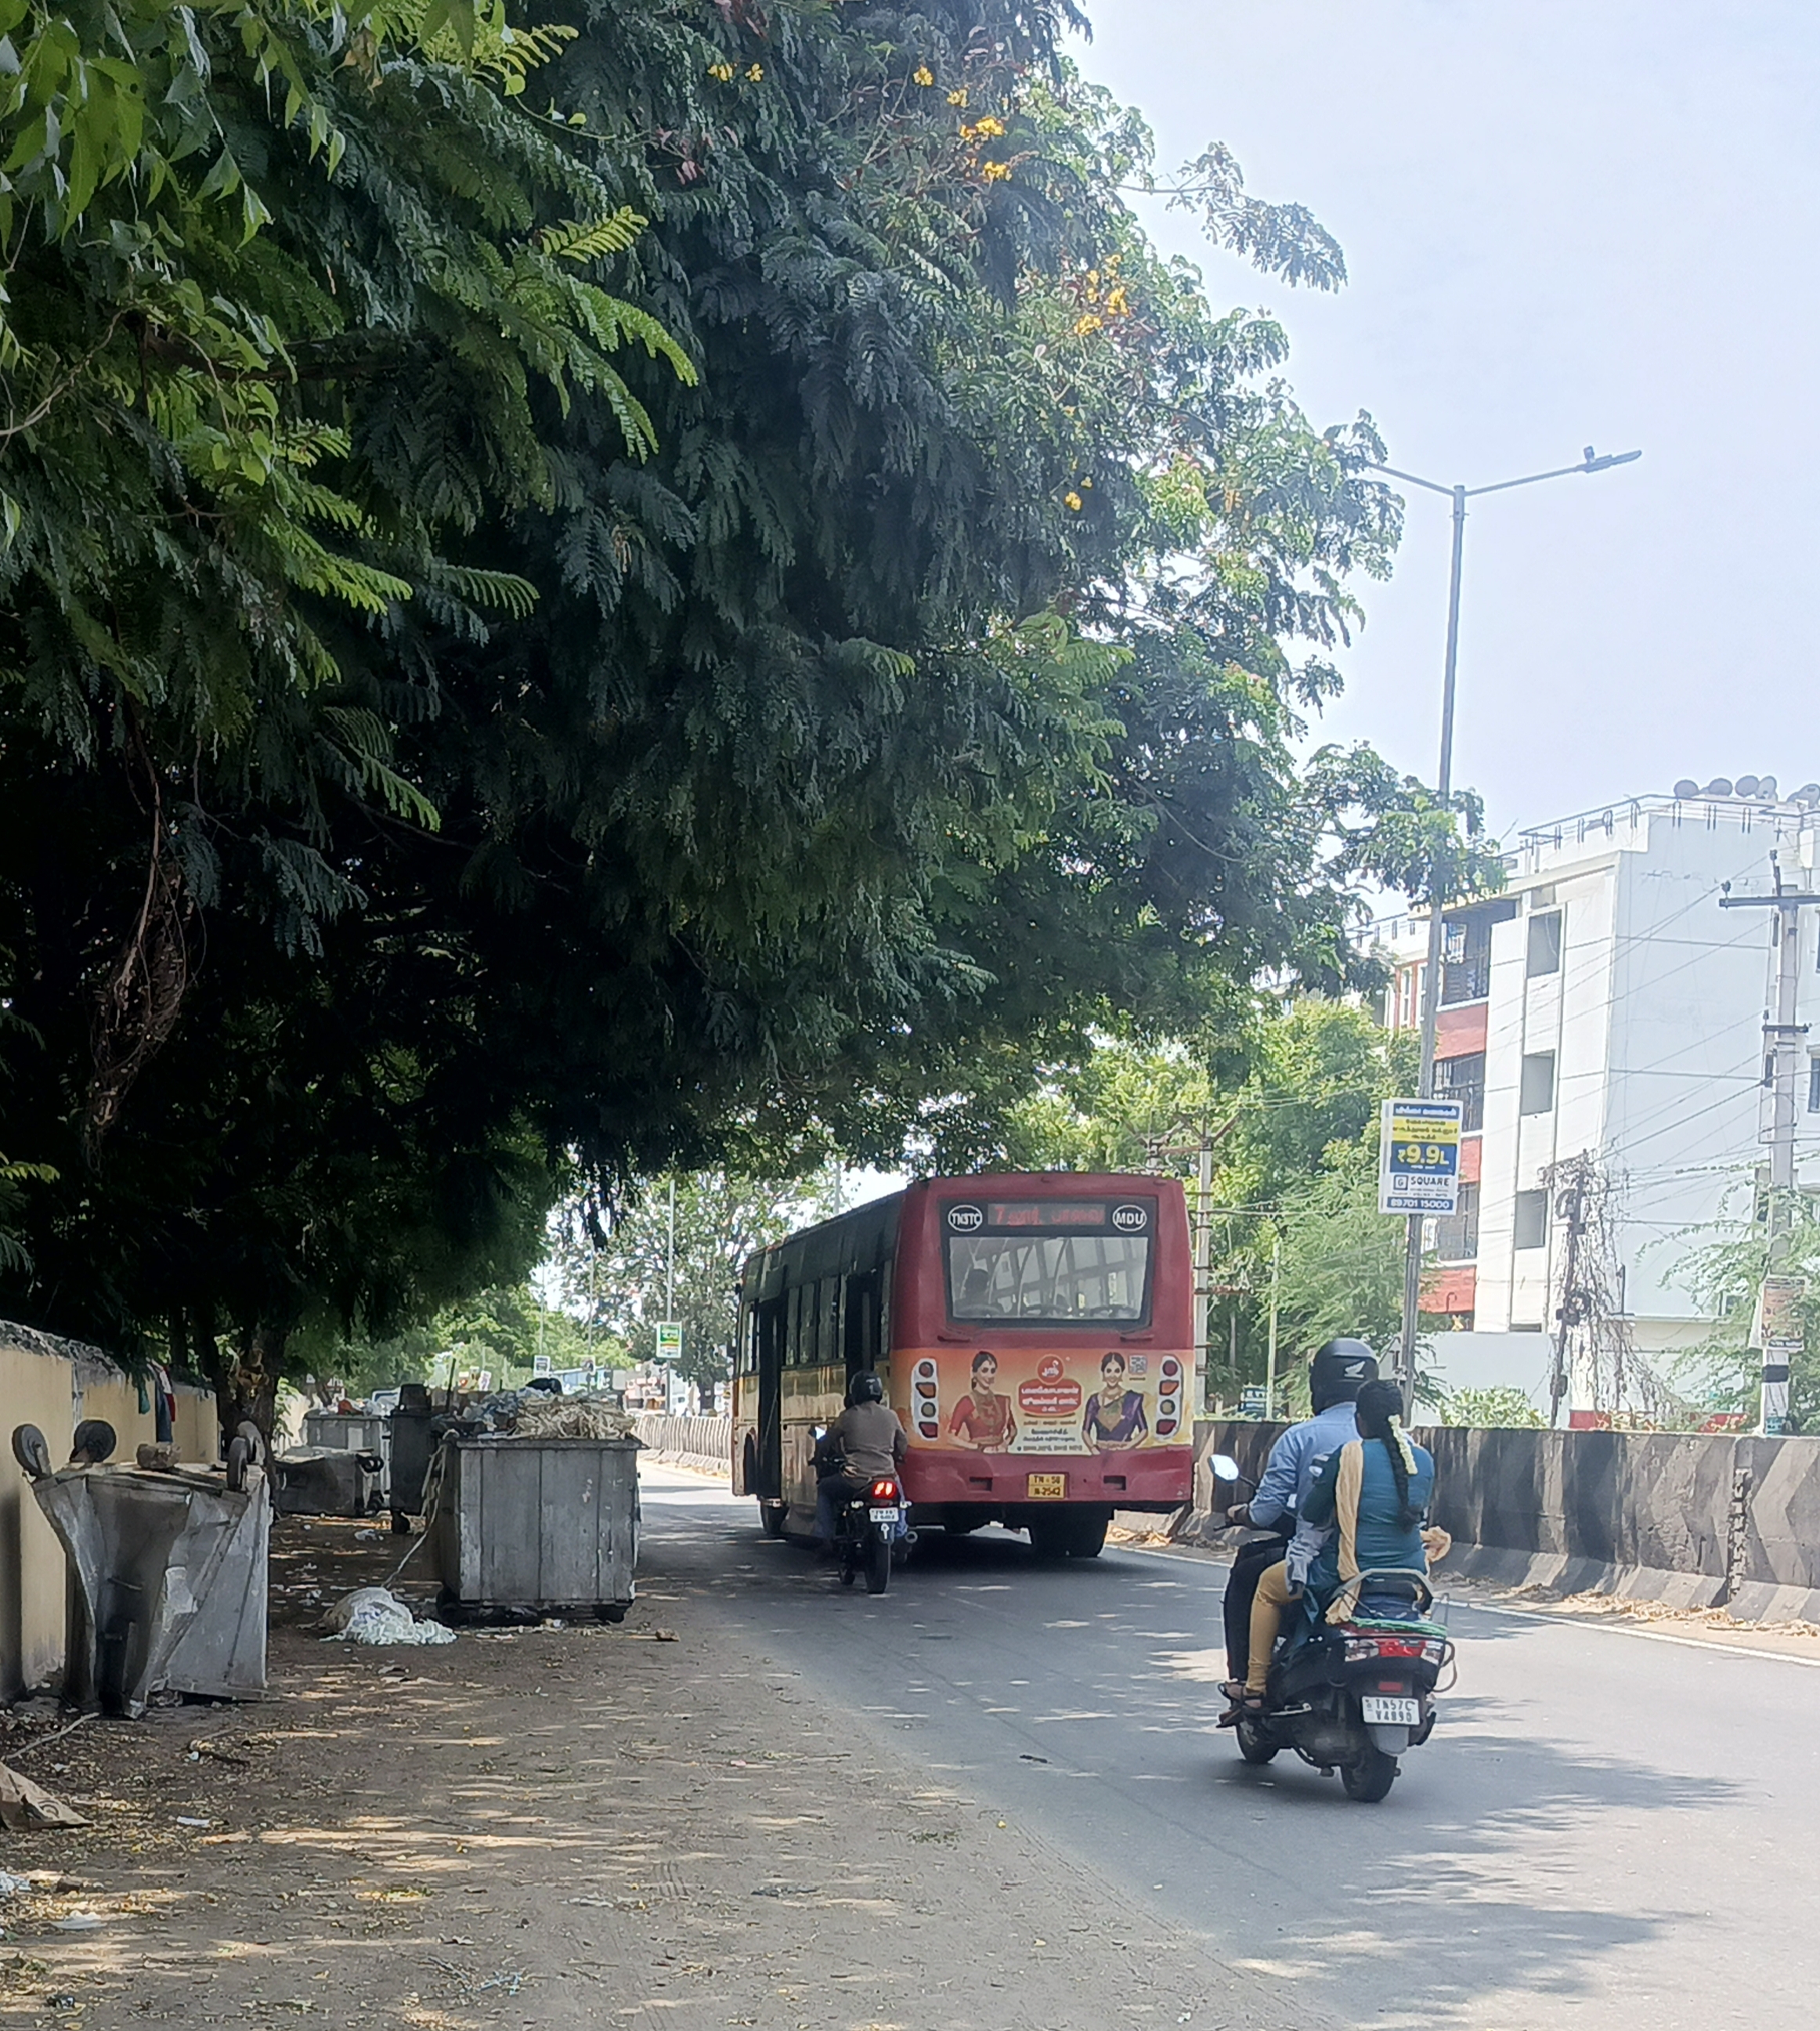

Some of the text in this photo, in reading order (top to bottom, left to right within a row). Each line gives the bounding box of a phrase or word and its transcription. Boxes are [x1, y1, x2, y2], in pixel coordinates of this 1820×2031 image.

[1410, 1176, 1450, 1187] SQUARE
[1420, 1199, 1450, 1209] 15000
[1116, 1212, 1144, 1224] MDU
